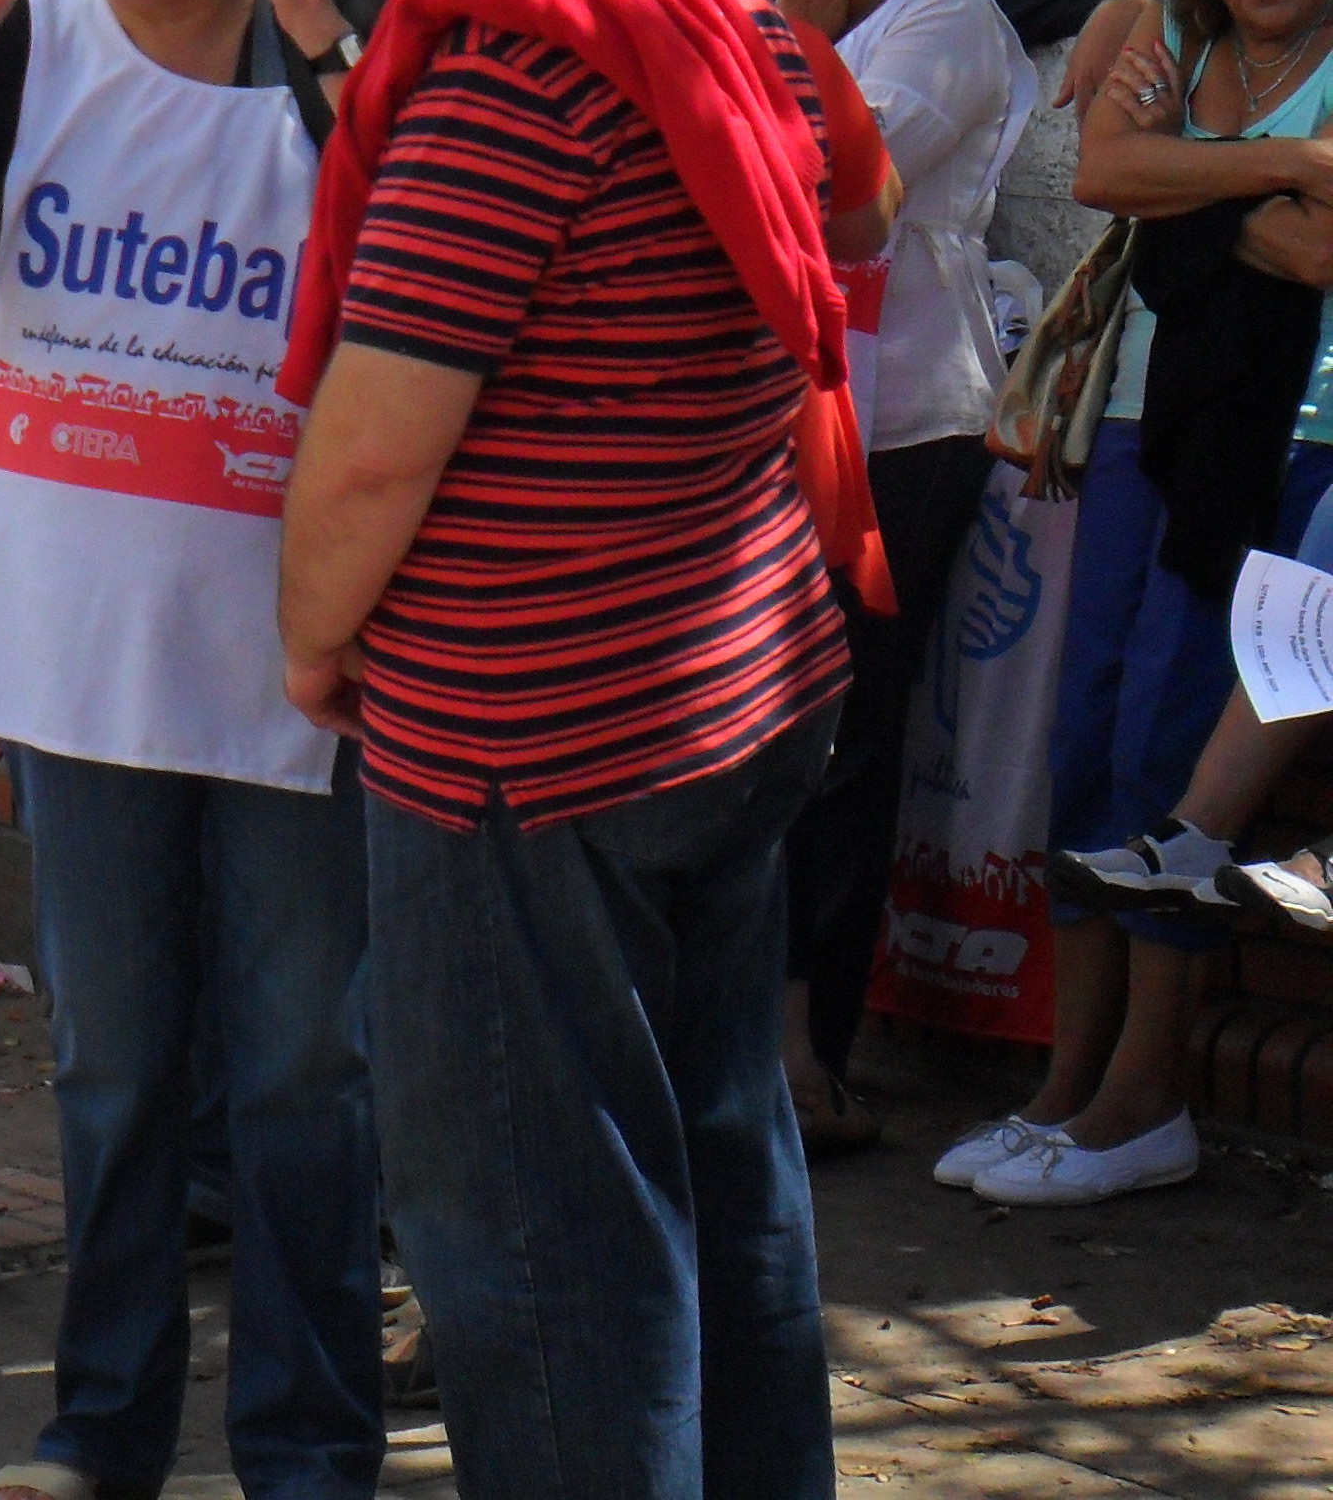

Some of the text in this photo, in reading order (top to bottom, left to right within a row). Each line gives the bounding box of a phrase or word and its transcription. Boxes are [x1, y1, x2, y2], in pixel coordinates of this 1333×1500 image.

[18, 181, 286, 322] Suteba
[99, 332, 119, 353] de
[126, 333, 144, 357] la
[152, 339, 250, 374] educación
[50, 421, 141, 466] CTERA
